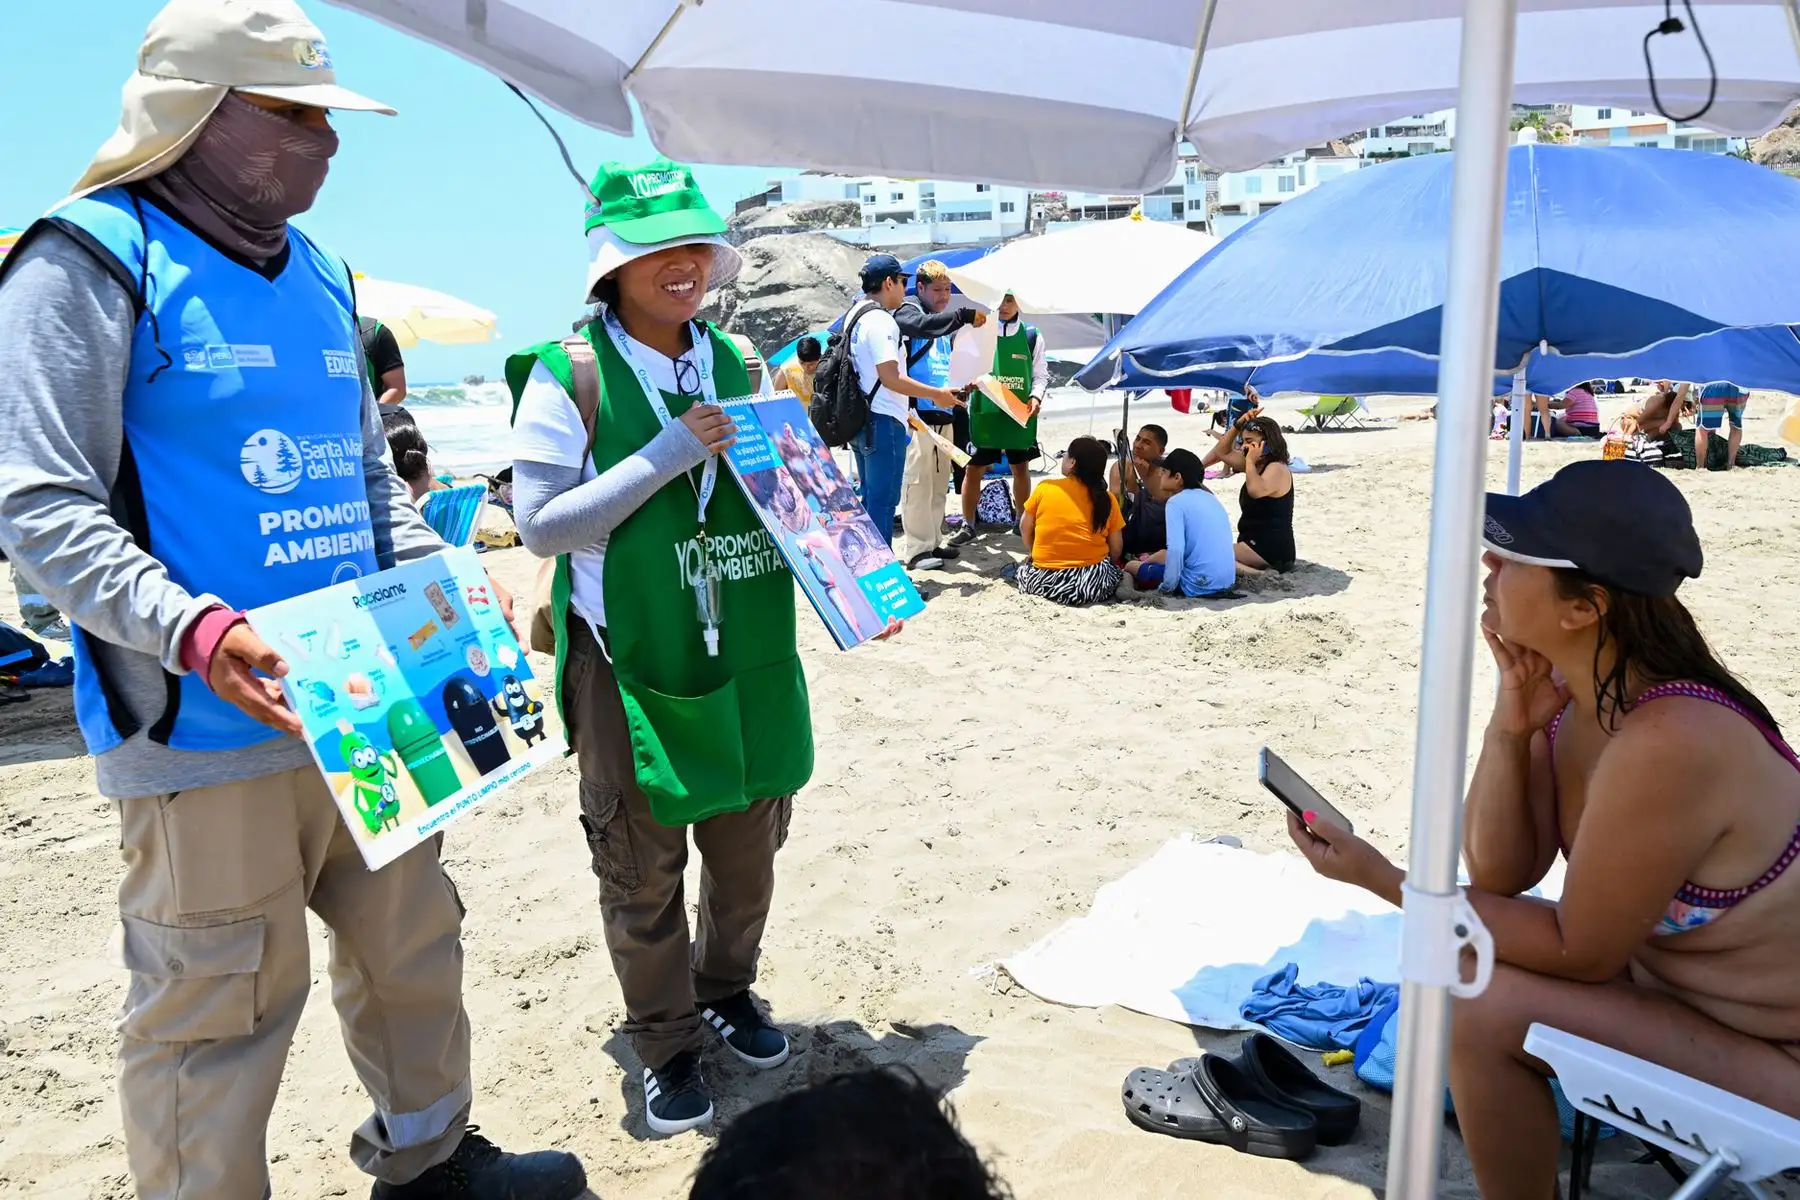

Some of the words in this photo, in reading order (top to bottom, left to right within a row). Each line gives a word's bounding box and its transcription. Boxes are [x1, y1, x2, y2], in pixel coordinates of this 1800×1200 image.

[300, 440, 344, 460] Santa
[307, 458, 331, 479] del
[330, 458, 355, 477] Mar
[258, 501, 370, 535] PROMOTO
[264, 529, 375, 567] AMBIENTA
[706, 528, 776, 557] PROMOTO
[675, 538, 701, 590] YO
[707, 549, 788, 581] AMBIENTA
[456, 793, 478, 811] PUNTO
[478, 780, 498, 798] LIMPIO
